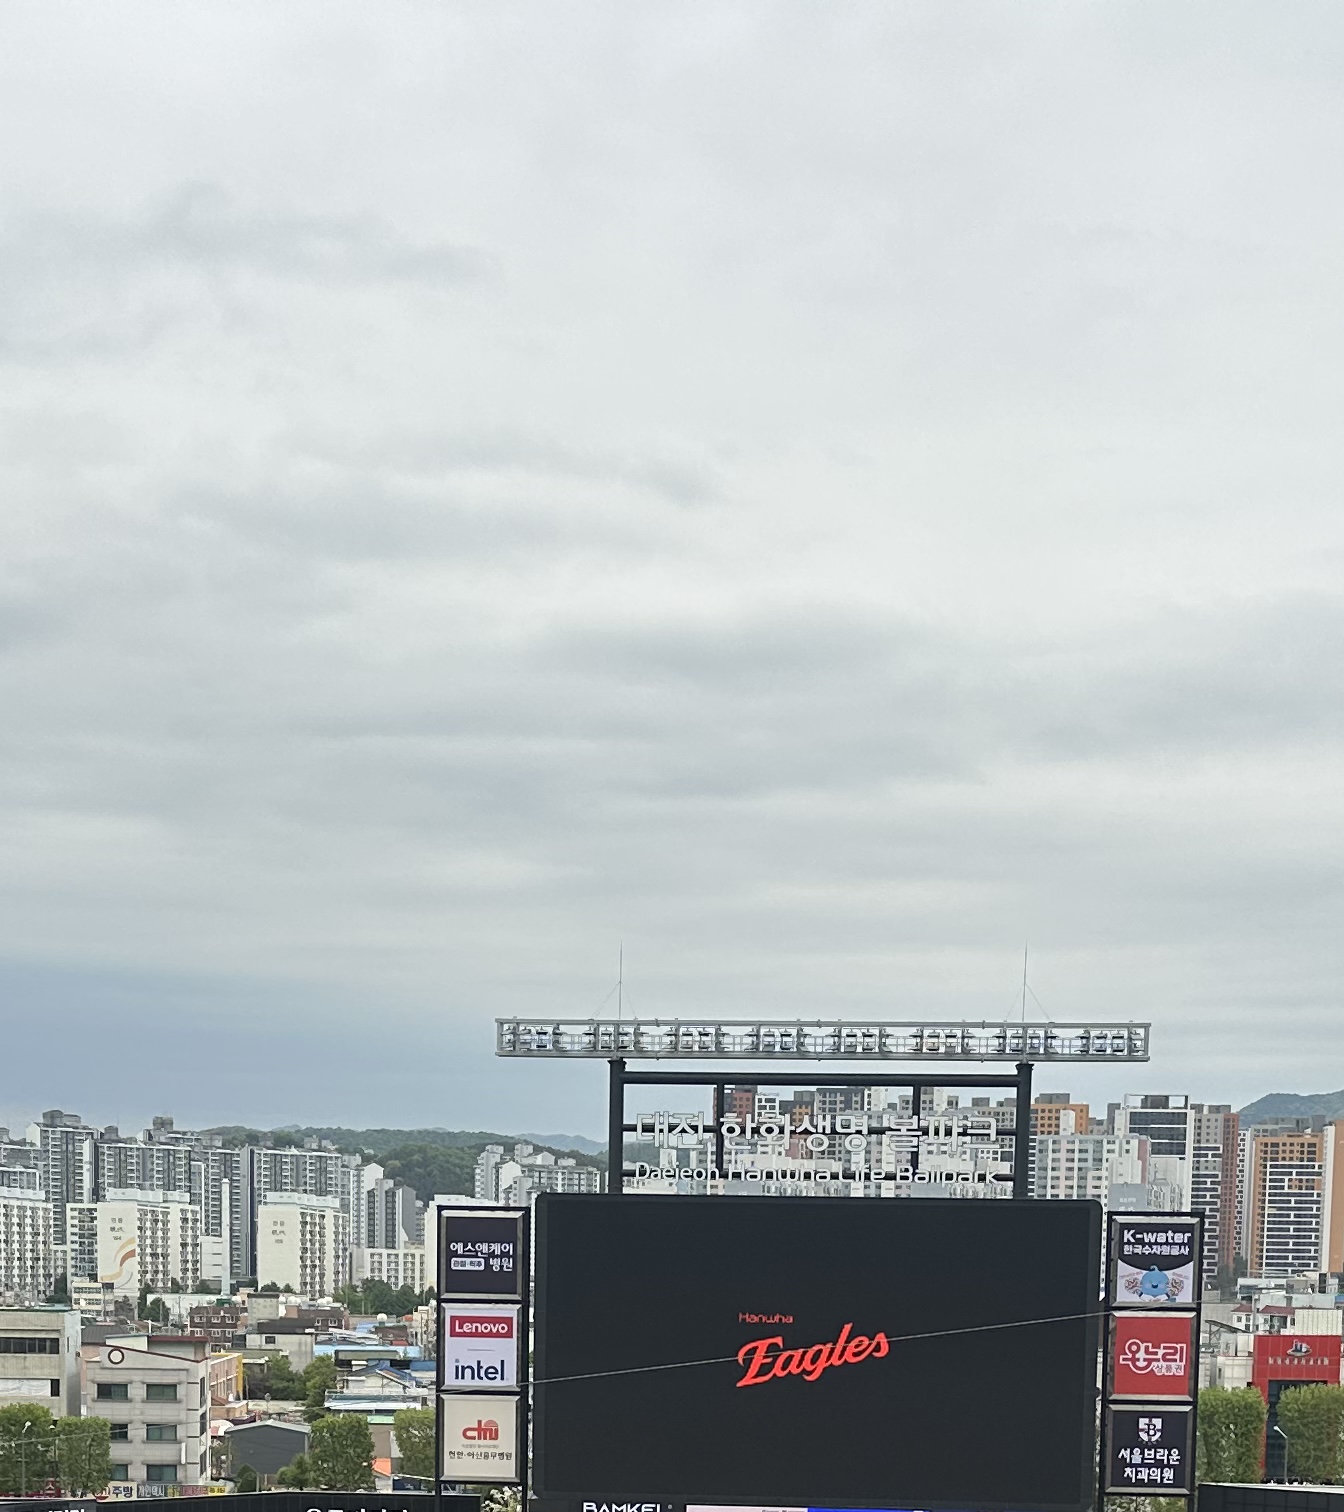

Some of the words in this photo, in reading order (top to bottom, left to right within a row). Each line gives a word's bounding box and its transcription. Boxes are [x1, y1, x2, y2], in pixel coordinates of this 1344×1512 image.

[636, 1112, 704, 1149] 대전
[720, 1112, 868, 1152] 한화생명
[885, 1115, 1000, 1152] 볼파크
[635, 1162, 719, 1184] Daejeon
[728, 1165, 831, 1182] Hanwha
[838, 1165, 886, 1182] Life
[896, 1165, 999, 1186] Ballpark
[1123, 1229, 1192, 1243] K-water
[450, 1242, 513, 1257] 에스앤케이
[1123, 1244, 1190, 1255] 한국수자원공사
[490, 1257, 513, 1272] 병원
[738, 1312, 794, 1323] Hanwha
[455, 1320, 508, 1333] Lenovo
[736, 1322, 889, 1388] Eagles
[1119, 1338, 1187, 1374] 온누리
[454, 1358, 505, 1381] intel
[1118, 1447, 1181, 1465] 서울브라운
[1124, 1467, 1174, 1484] 치과의원
